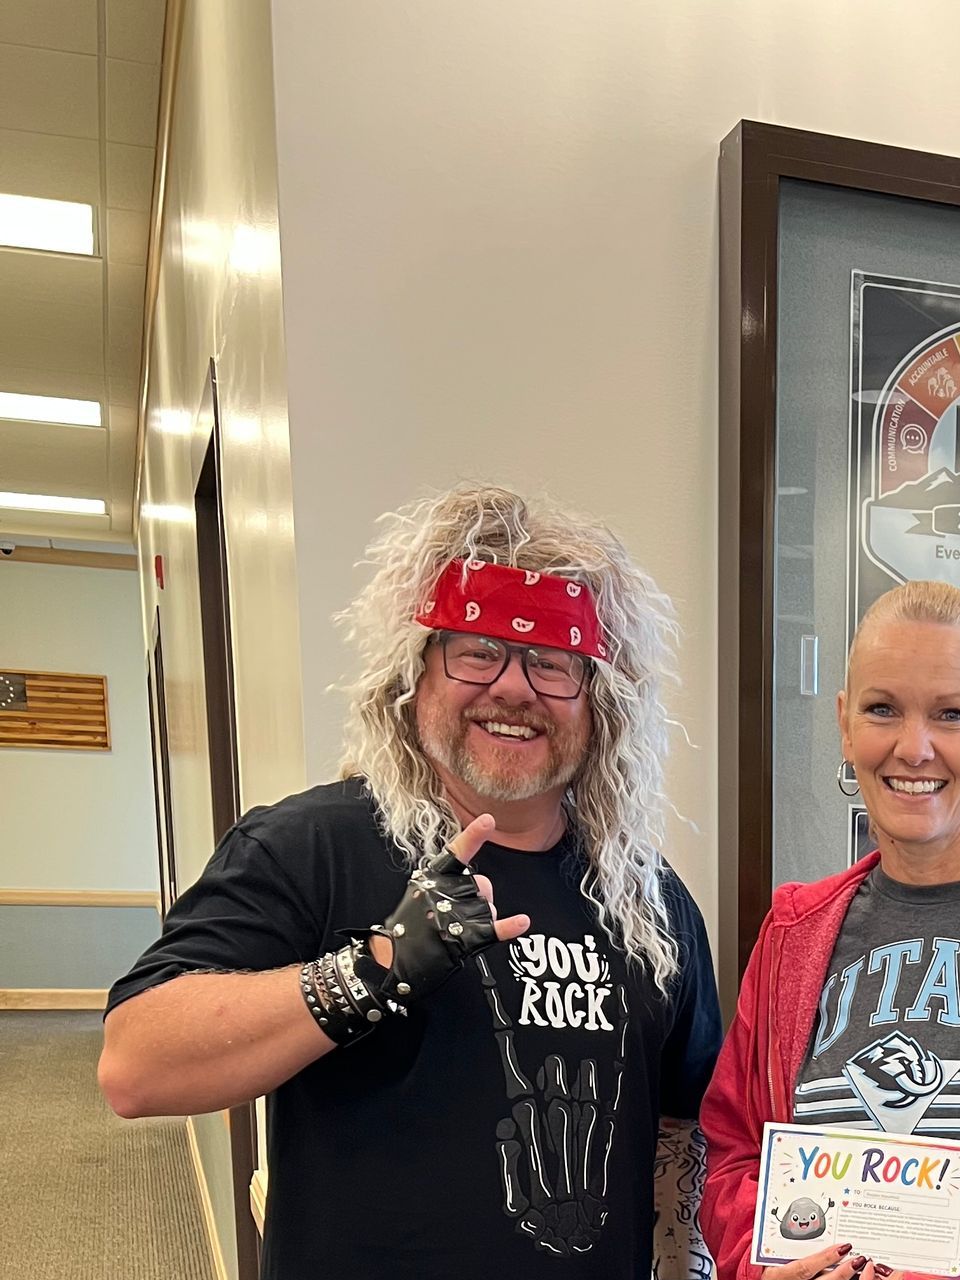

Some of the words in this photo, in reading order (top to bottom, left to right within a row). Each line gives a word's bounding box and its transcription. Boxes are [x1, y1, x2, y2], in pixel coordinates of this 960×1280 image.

[908, 348, 949, 386] ACCOUNTABLE
[888, 398, 906, 472] COMMUNICATION
[516, 934, 601, 983] YOU
[518, 976, 614, 1031] ROCK
[798, 1146, 853, 1181] YOU
[861, 1147, 951, 1191] ROCK!
